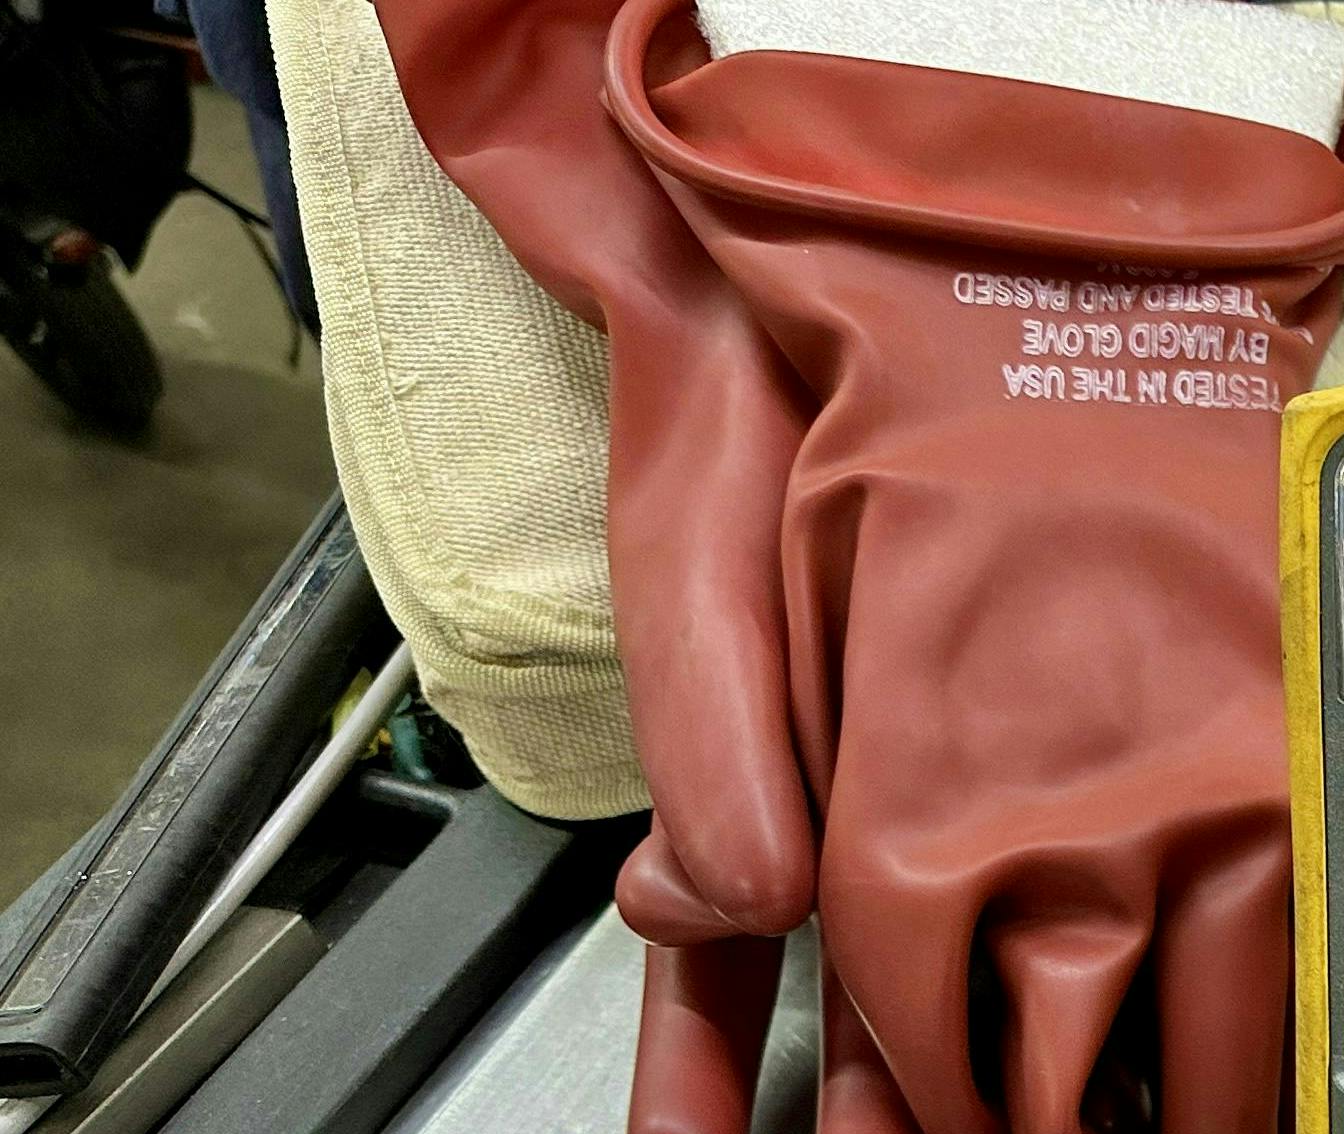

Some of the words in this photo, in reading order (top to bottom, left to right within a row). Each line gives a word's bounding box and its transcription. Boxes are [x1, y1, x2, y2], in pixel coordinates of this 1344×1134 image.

[952, 271, 1072, 313] PASSED
[1078, 282, 1138, 313] AND
[1145, 284, 1259, 319] TESTED
[1021, 318, 1122, 359] GLOVE
[1128, 322, 1226, 361] MAGID
[1228, 330, 1270, 365] BY
[1001, 363, 1066, 401] USA
[1071, 367, 1132, 404] THE
[1136, 369, 1167, 405] IN
